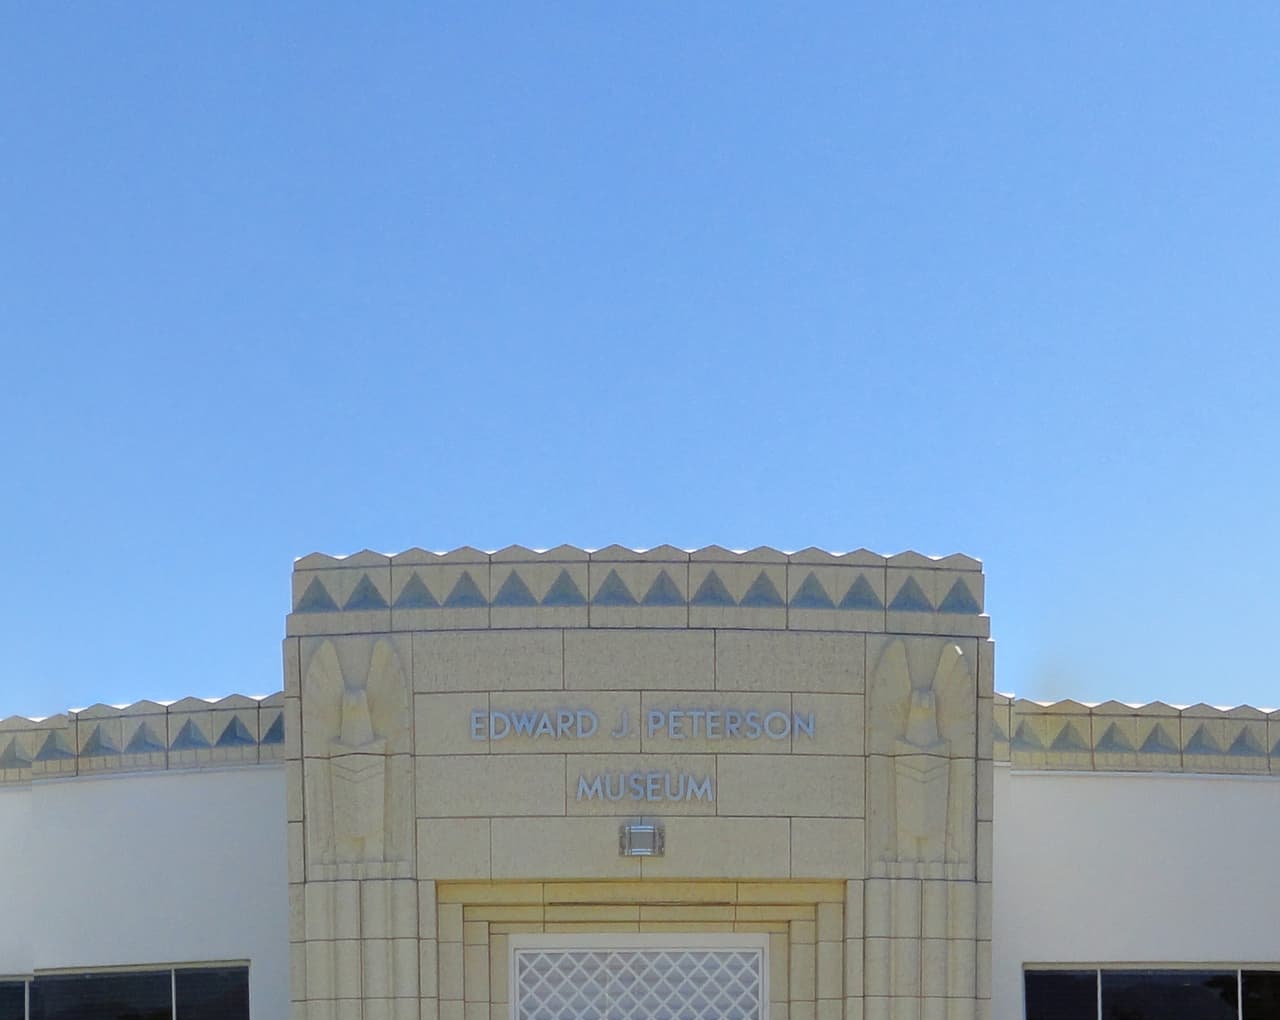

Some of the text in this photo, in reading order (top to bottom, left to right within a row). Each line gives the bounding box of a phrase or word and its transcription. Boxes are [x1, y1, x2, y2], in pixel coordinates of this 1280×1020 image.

[471, 709, 599, 740] EDWARD
[647, 709, 817, 740] PETERSON
[577, 772, 714, 801] MUSEUM
